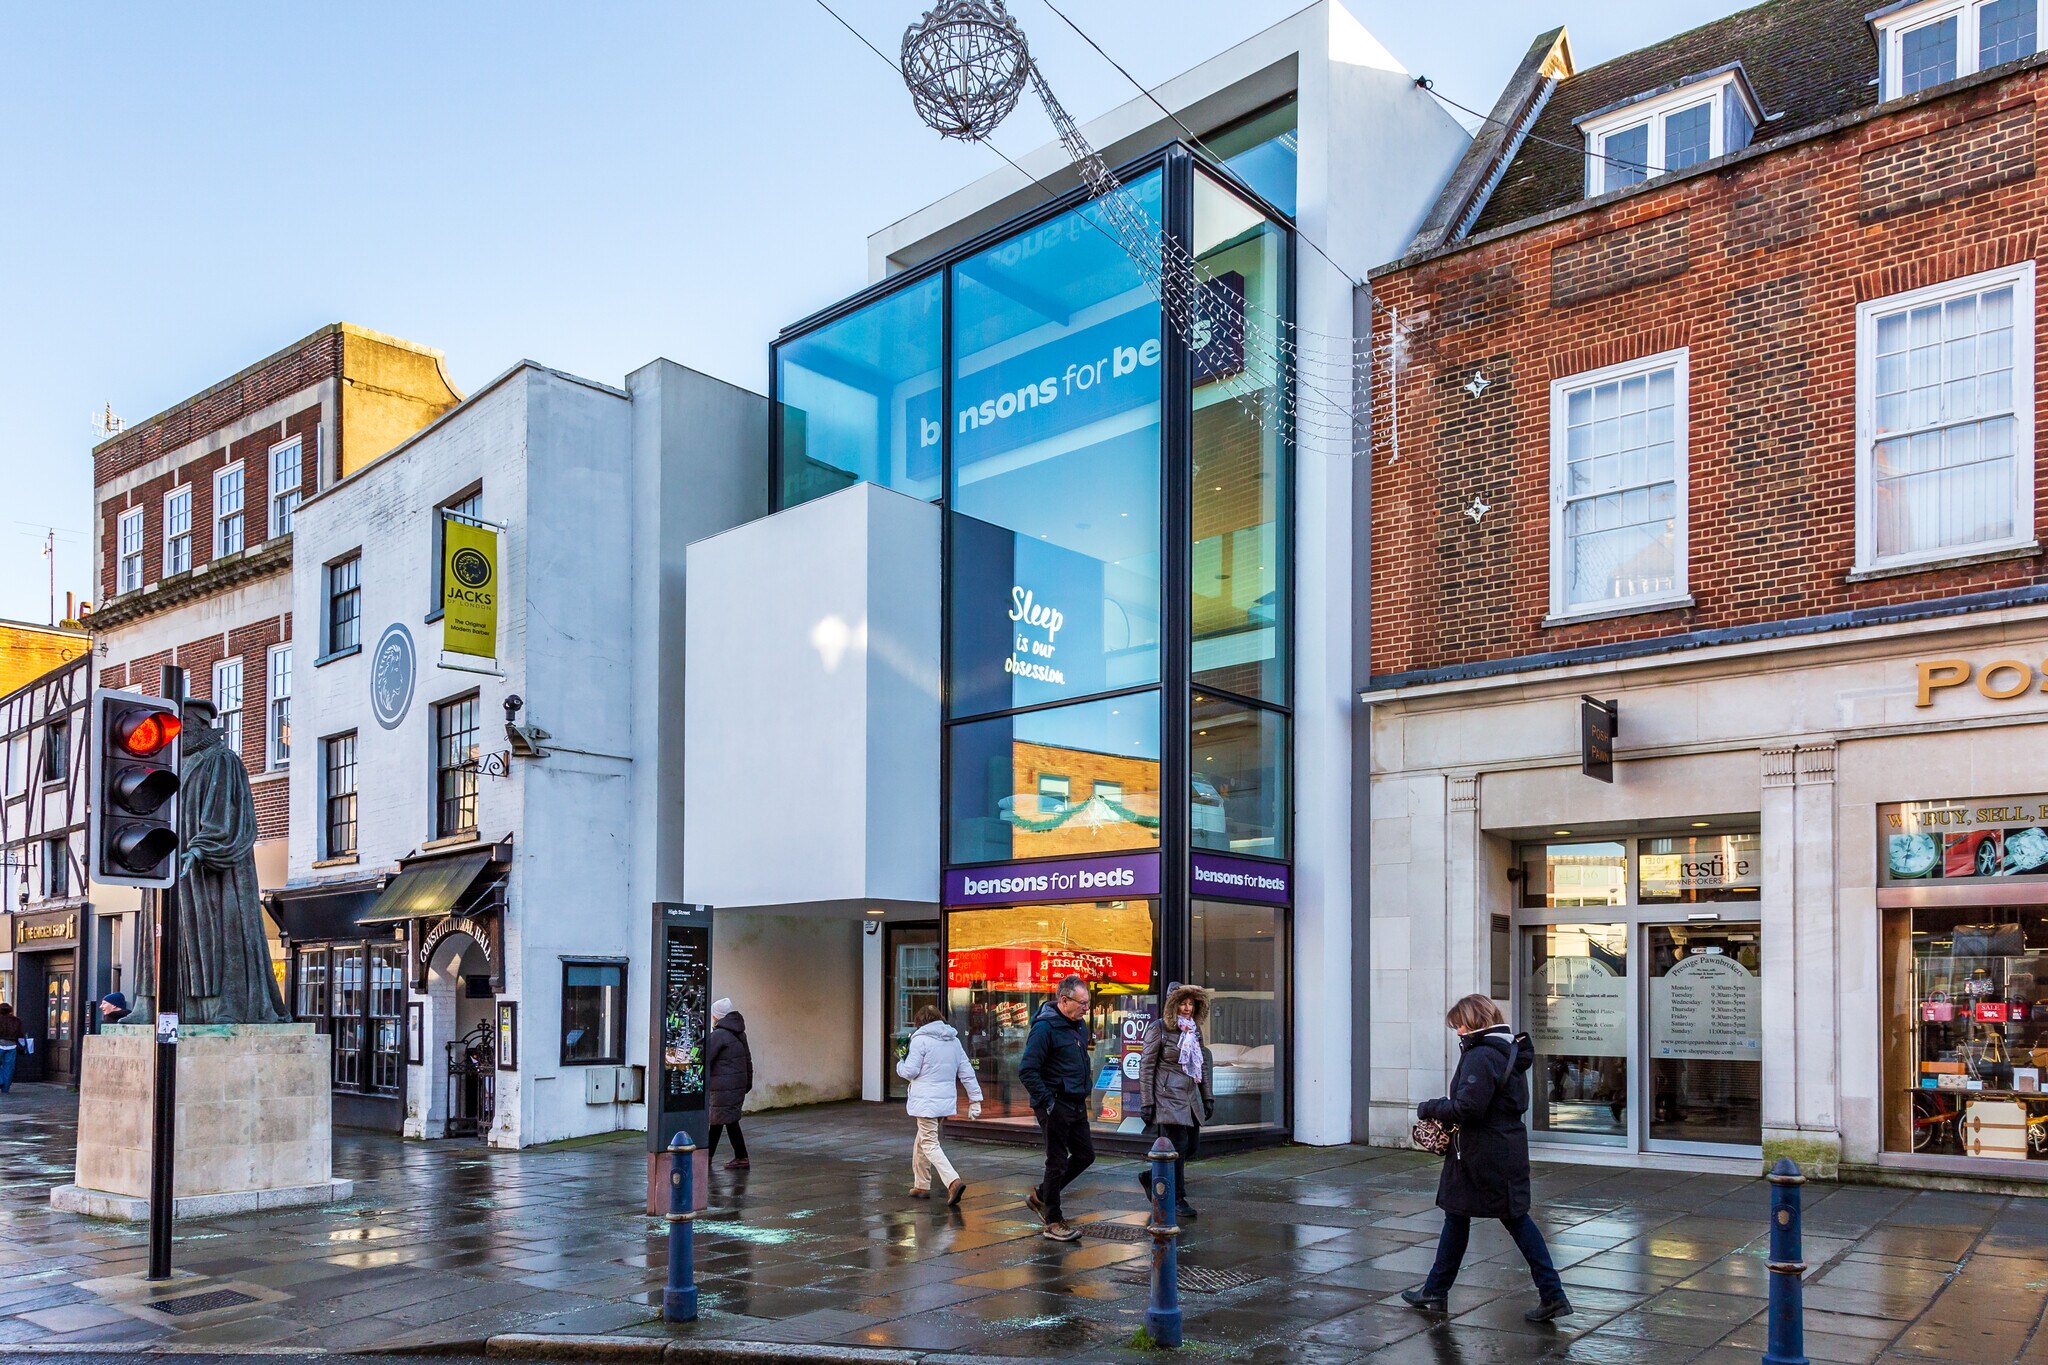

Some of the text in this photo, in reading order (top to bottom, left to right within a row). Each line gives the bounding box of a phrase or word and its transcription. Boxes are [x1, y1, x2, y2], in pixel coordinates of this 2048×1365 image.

[920, 377, 1057, 448] bnsons
[1062, 357, 1108, 396] for
[447, 588, 491, 605] JACKS
[460, 600, 491, 611] LONDON
[1008, 585, 1063, 642] Sleep
[450, 624, 490, 636] Modern Barber
[465, 620, 486, 630] Original
[1016, 633, 1055, 658] is our
[1004, 652, 1065, 685] obsession
[1915, 659, 2048, 707] PO
[1591, 725, 1608, 742] POSH
[1591, 745, 1609, 763] PAWN
[1924, 808, 1972, 826] BUY,
[1976, 806, 2035, 824] SELL,
[1679, 855, 1750, 880] restie
[963, 867, 1134, 895] bensons for beds
[1195, 866, 1285, 891] bensons for beds
[1665, 877, 1723, 886] PAWNBROKERS
[25, 927, 33, 939] THE
[52, 923, 66, 937] SHOP
[420, 917, 474, 963] CONSTITUTIONAL
[1671, 956, 1744, 977] Prestige Pawnbrokers
[1132, 1012, 1151, 1020] years
